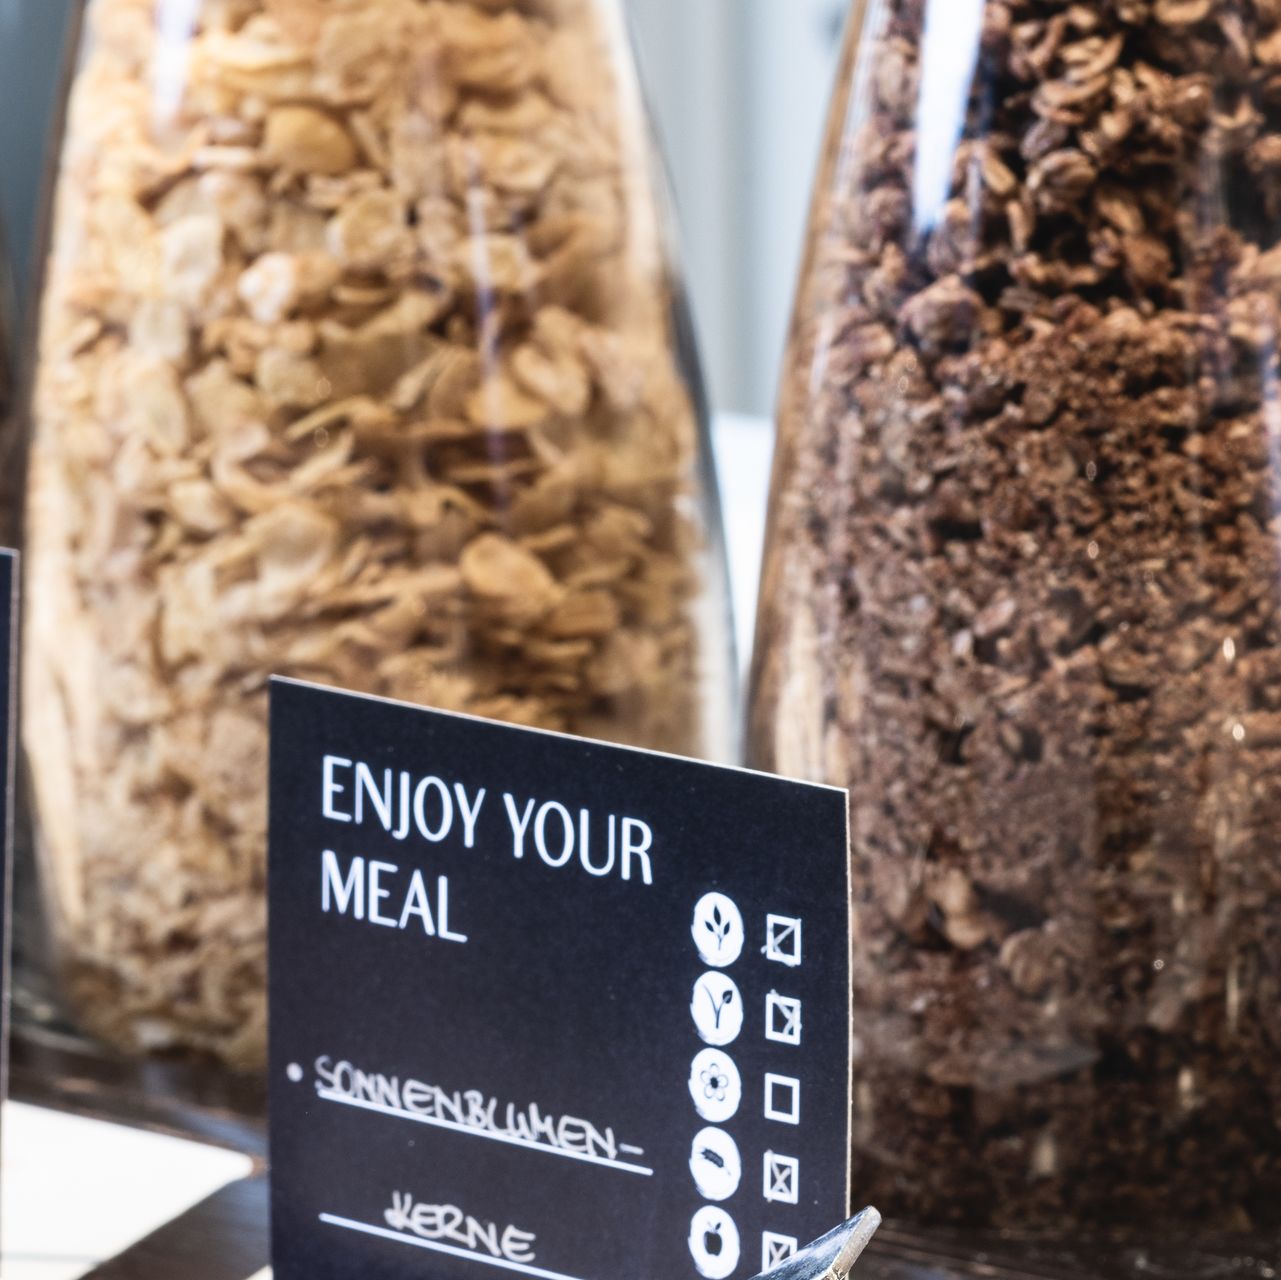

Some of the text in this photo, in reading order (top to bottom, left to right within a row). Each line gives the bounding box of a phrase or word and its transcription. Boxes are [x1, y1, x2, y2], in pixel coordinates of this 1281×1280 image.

[322, 754, 653, 885] ENJOY YOUR
[321, 849, 468, 943] MEAL
[313, 1055, 645, 1160] SONNENBLUMEN-
[383, 1190, 537, 1263] KERNE
